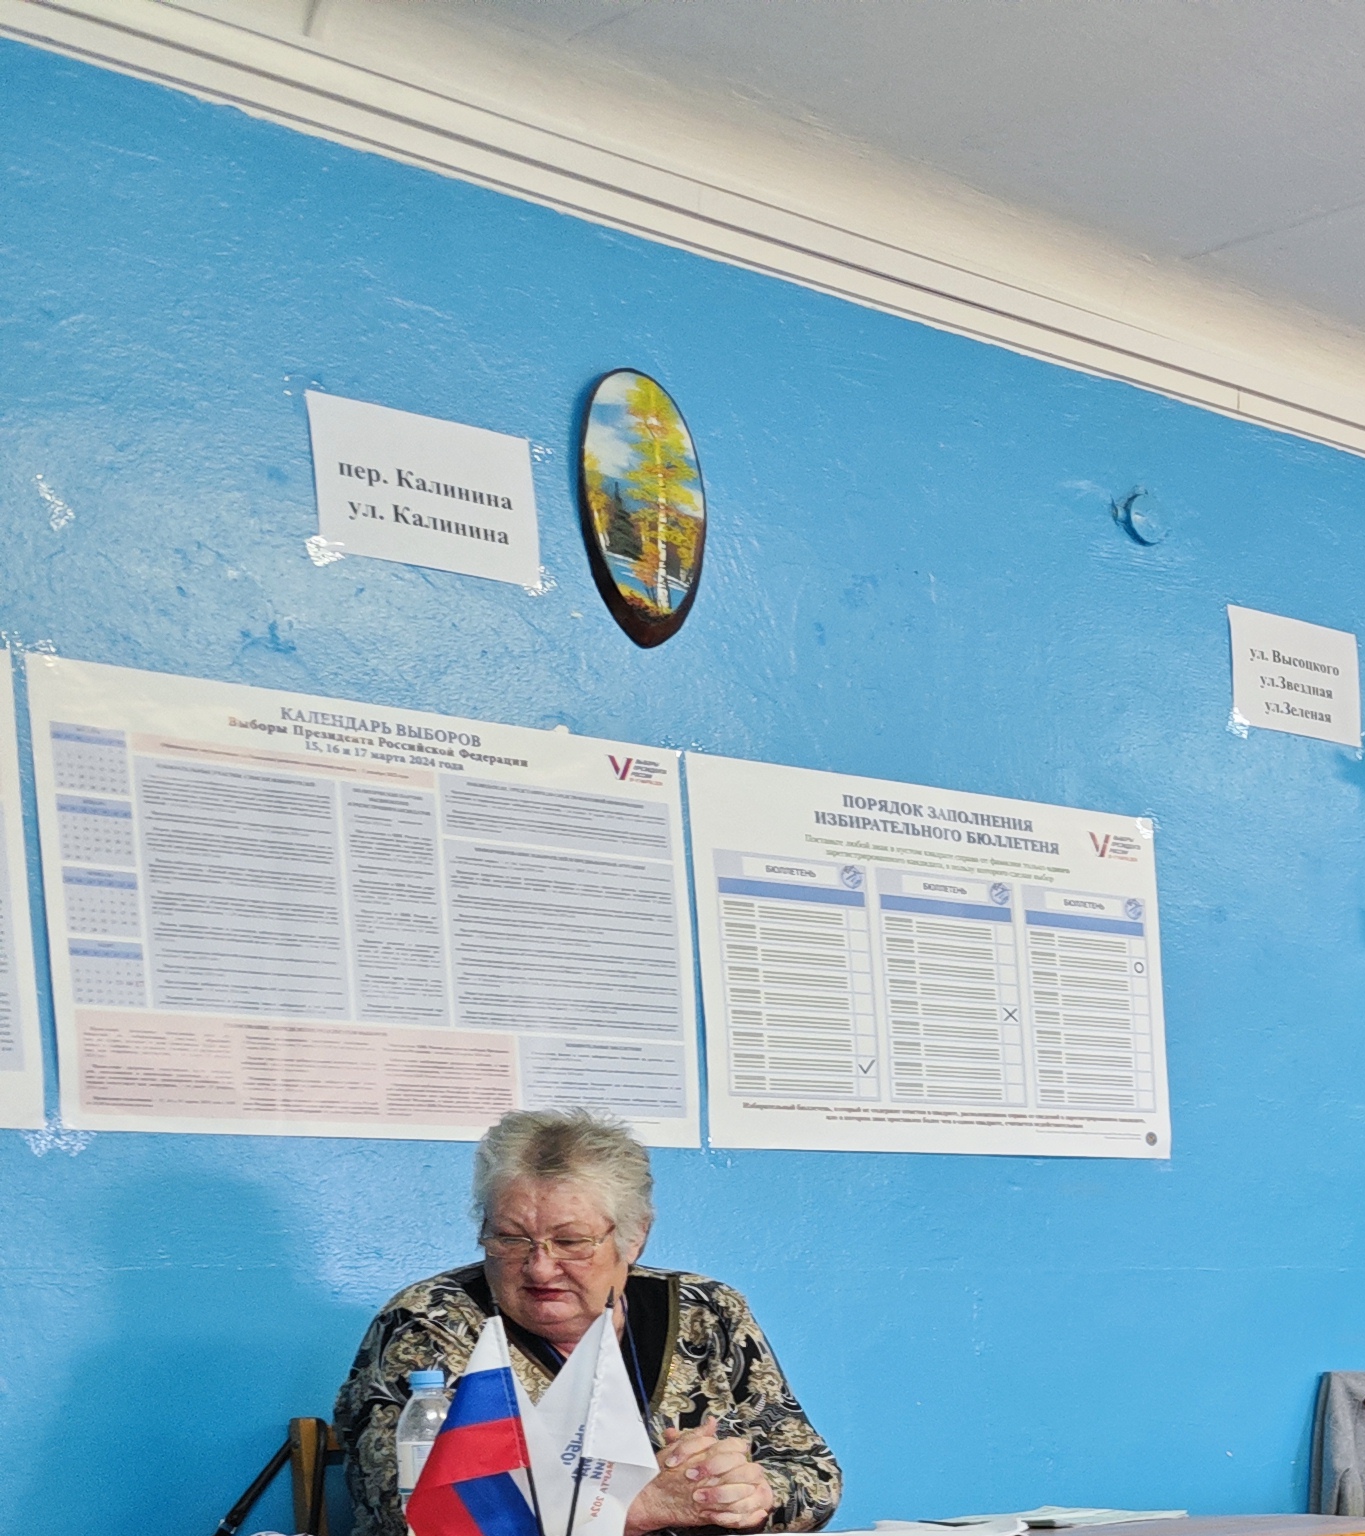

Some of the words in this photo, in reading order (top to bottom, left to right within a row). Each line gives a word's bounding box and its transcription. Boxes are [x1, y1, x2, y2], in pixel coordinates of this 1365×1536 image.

[338, 461, 389, 487] пер.
[395, 468, 514, 511] Калинина
[347, 500, 385, 521] ул.
[392, 503, 510, 546] Калинина
[1249, 648, 1269, 661] ул.
[1272, 649, 1340, 677] Высоцкого
[228, 715, 288, 735] Выборы
[293, 725, 375, 746] Президента
[378, 735, 455, 757] Российской
[459, 747, 529, 768] Федерации
[280, 706, 392, 735] КАЛЕНДАРЬ
[395, 723, 482, 748] ВЫБОРОВ
[305, 740, 323, 753] 15,
[326, 742, 341, 754] 16
[354, 746, 368, 758] 17
[370, 751, 406, 765] марта
[409, 754, 436, 768] 2024
[438, 759, 464, 771] года
[814, 810, 962, 843] ИЗБИРАТЕЛЬНОГО
[966, 830, 1060, 856] БЮЛЛЕТЕНЯ
[842, 794, 924, 819] ПОРЯДОК
[927, 805, 1034, 833] ЗАПОЛНЕНИЯ
[765, 864, 817, 879] БЮЛЛЕТЕНЬ
[922, 882, 968, 895] БЮЛЛЕТЕНЬ
